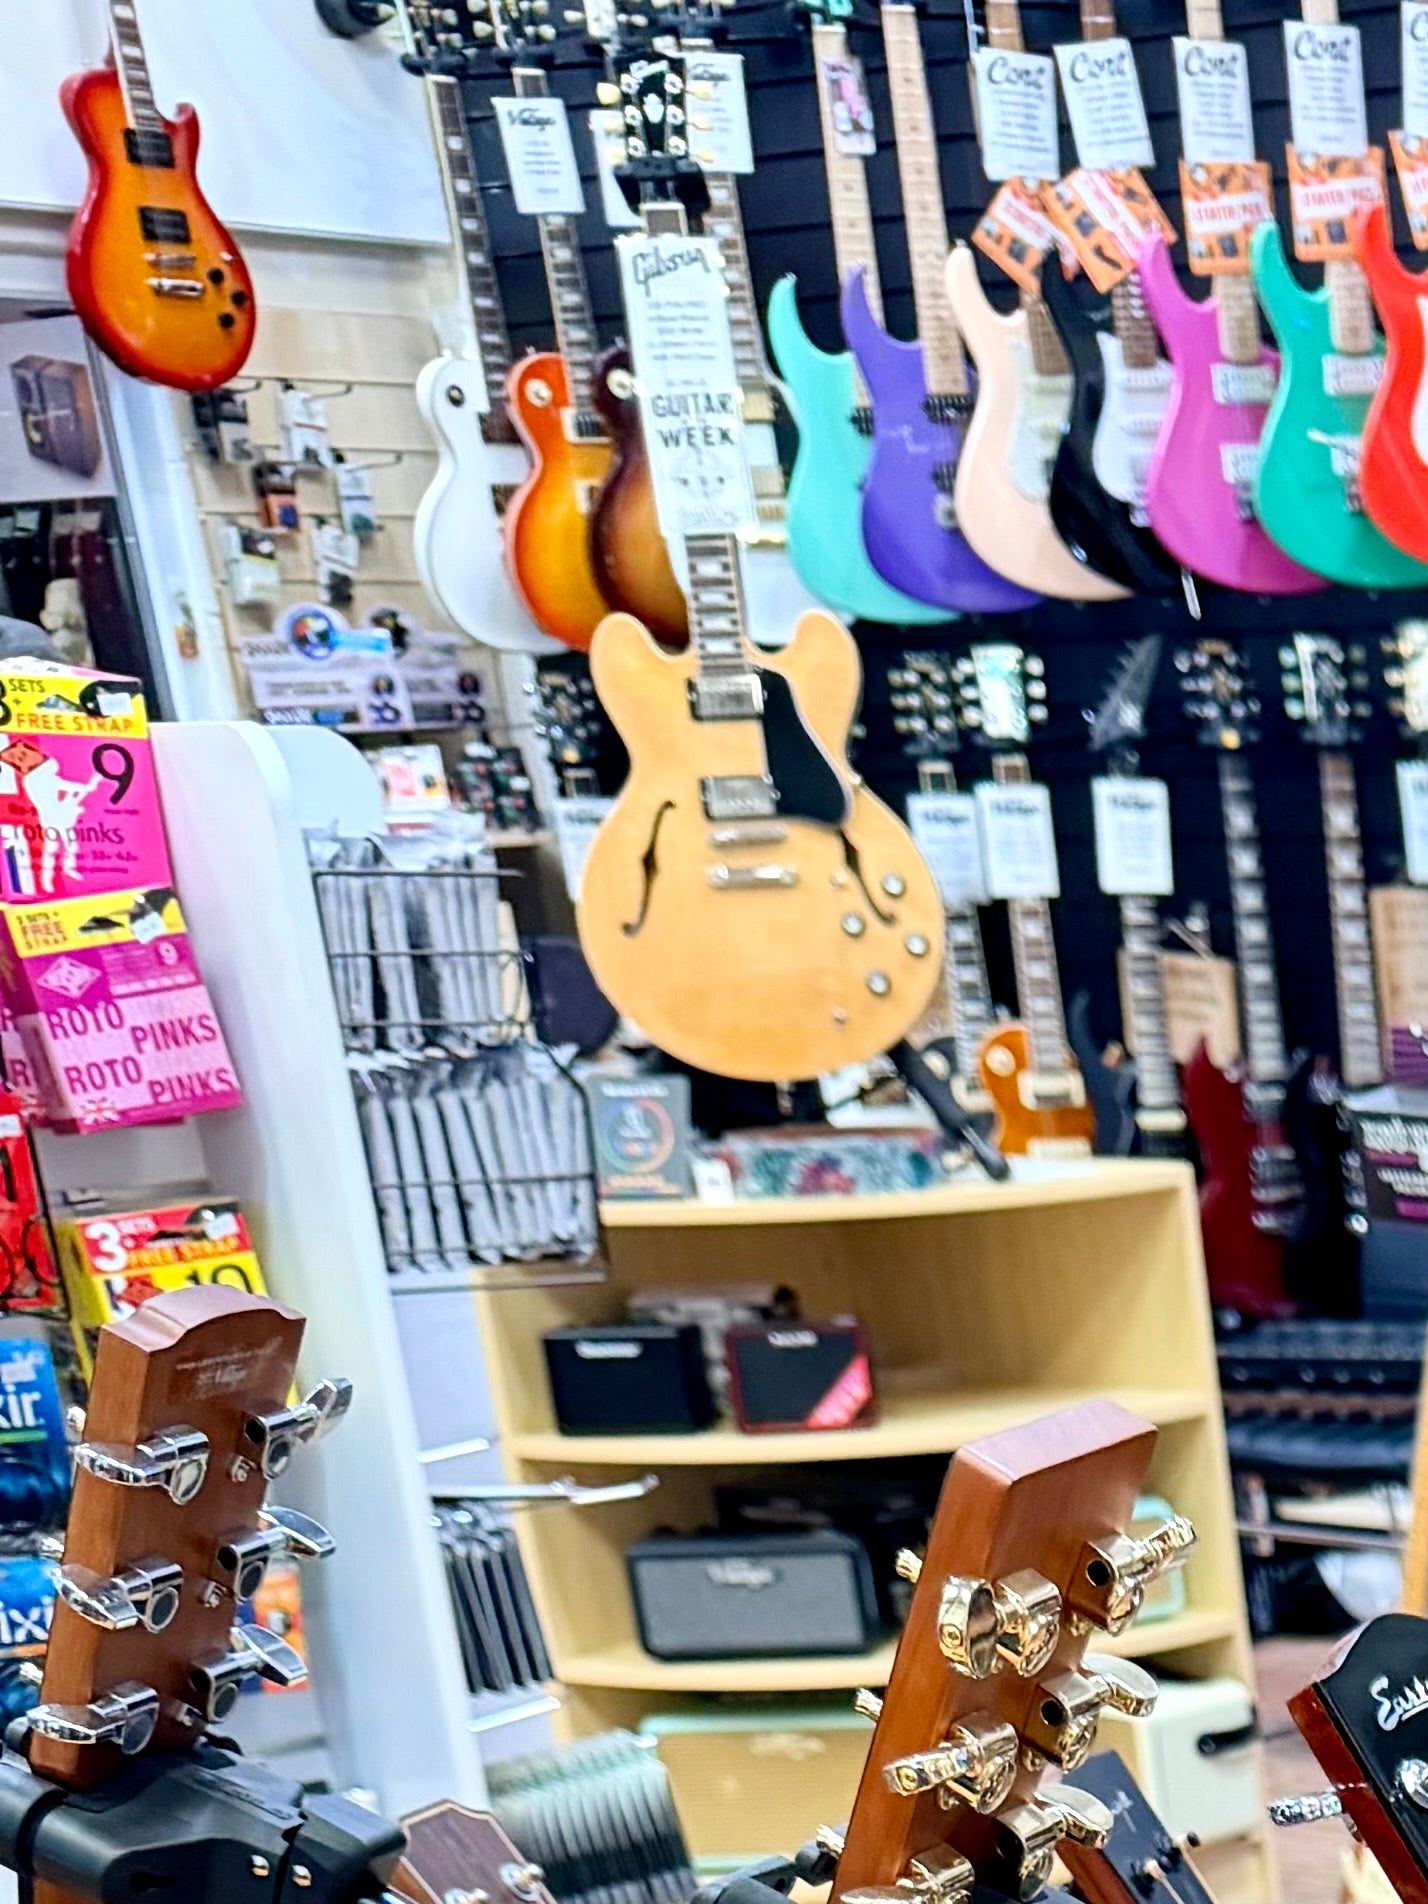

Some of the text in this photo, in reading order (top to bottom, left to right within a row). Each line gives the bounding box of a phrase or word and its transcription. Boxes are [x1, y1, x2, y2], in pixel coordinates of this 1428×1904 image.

[657, 426, 737, 448] WEEK
[8, 678, 46, 694] SETS
[16, 713, 66, 730] FREE
[92, 743, 134, 805] 9
[66, 820, 125, 846] pinks
[46, 1001, 124, 1041] ROTO
[130, 1012, 218, 1055] PINKS
[64, 1055, 142, 1096] ROTO
[148, 1067, 234, 1106] PINKS
[85, 1221, 128, 1272] 3
